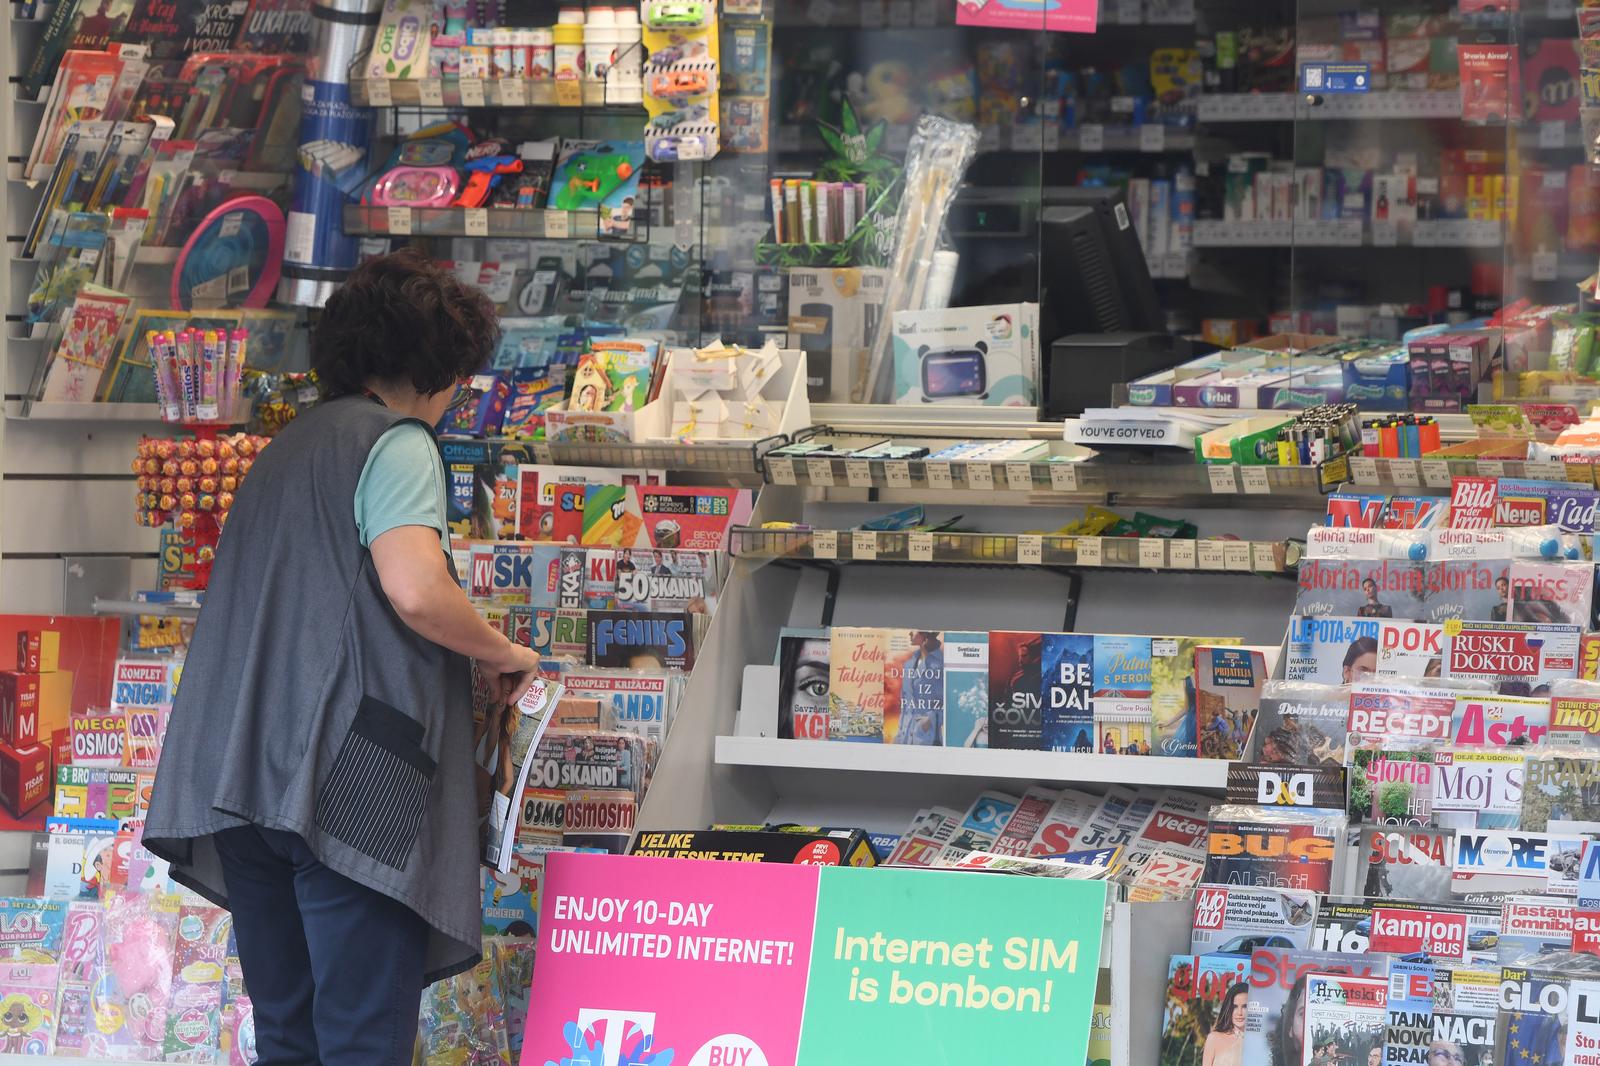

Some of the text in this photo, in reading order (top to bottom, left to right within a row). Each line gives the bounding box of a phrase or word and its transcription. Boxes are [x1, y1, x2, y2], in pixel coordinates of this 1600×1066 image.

[381, 24, 397, 54] BIO
[397, 19, 418, 58] bibo
[1080, 427, 1165, 439] YOU'VE GOT VELO
[443, 445, 484, 457] Official
[1452, 482, 1497, 508] Bild
[1466, 508, 1482, 516] der
[1496, 502, 1541, 524] Neue
[1314, 529, 1345, 544] gloria
[1439, 530, 1472, 546] gloria
[1300, 560, 1360, 591] gloria
[1424, 561, 1492, 593] gloria
[618, 572, 705, 601] 50 SKANDI
[596, 618, 687, 657] FENIKS
[1382, 627, 1442, 652] DOK
[1455, 635, 1515, 653] RUSKI
[30, 655, 37, 668] S
[1454, 653, 1535, 672] DOKTOR
[120, 666, 162, 680] KOMPLET
[890, 668, 941, 679] DJEVOJ
[1104, 673, 1150, 684] S PERON
[528, 685, 544, 695] SVE
[568, 679, 663, 691] KOMPLET KRIŽALJKI
[918, 684, 932, 695] IZ
[20, 692, 35, 700] TISAK
[1278, 703, 1317, 717] Dobra
[20, 713, 35, 739] M
[74, 719, 125, 730] MEGA
[1351, 710, 1451, 737] RECEPT
[1435, 753, 1452, 764] Lisa
[62, 767, 67, 782] 3
[530, 760, 618, 787] 50 SKANDI
[1366, 755, 1432, 785] gloria
[24, 774, 44, 791] TISAK
[1435, 766, 1494, 808] Moj
[24, 783, 43, 801] PAKET
[640, 833, 695, 849] VELIKE
[998, 836, 1028, 849] SLO
[1209, 833, 1337, 861] BUG
[1197, 890, 1225, 912] Auto
[1251, 895, 1277, 903] naplatne
[554, 896, 714, 928] ENJOY 10-DAY
[1252, 910, 1279, 918] pokušaja
[1373, 912, 1463, 941] kamion
[550, 929, 795, 966] UNLIMITED INTERNET!
[834, 927, 1079, 974] Internet SIM
[1421, 938, 1460, 955] & BUS
[1502, 969, 1527, 981] Dar!
[848, 967, 1053, 1013] is bonbon!
[1316, 982, 1375, 1001] Hrvatski
[1500, 980, 1568, 1014] GLO
[1433, 1016, 1496, 1046] NACI
[1575, 1033, 1596, 1048] Što
[708, 1045, 753, 1066] BUY
[1386, 1046, 1431, 1064] BRAK
